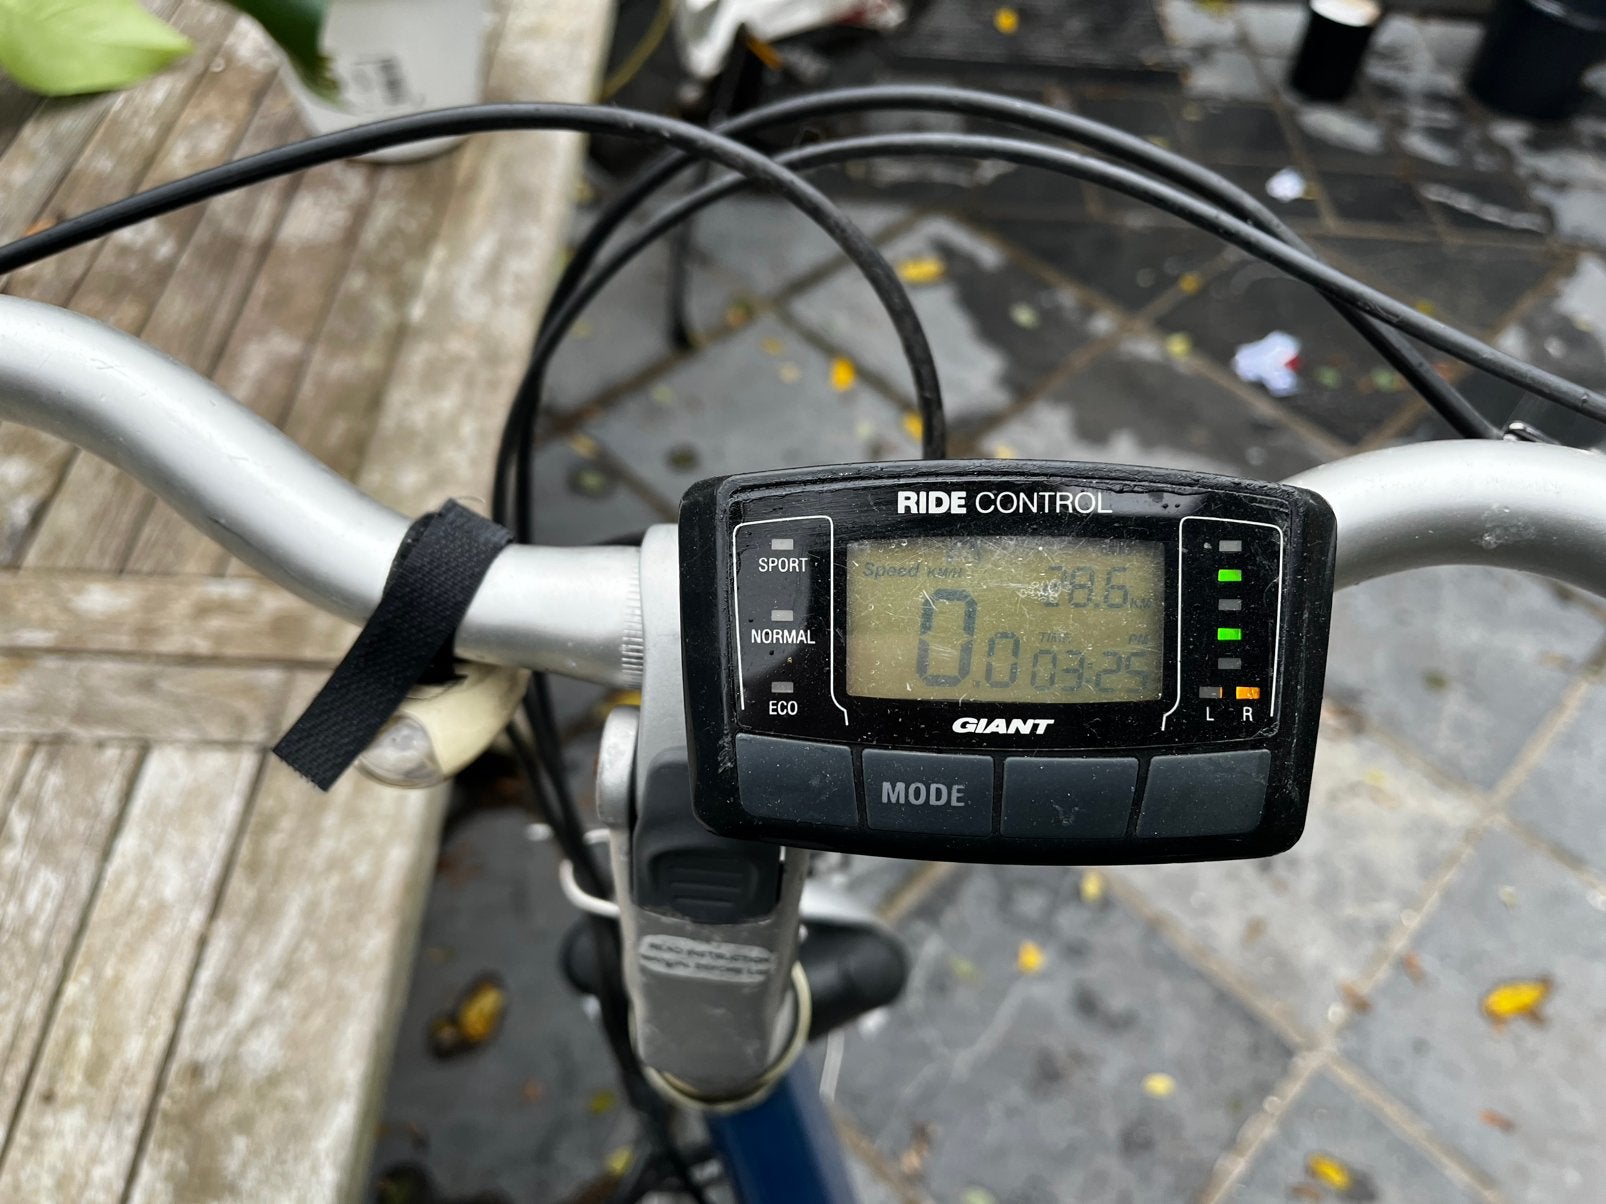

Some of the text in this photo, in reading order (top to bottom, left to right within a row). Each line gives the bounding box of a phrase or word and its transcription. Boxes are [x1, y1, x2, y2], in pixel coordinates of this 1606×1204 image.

[897, 491, 1113, 514] RIDE CONTROL
[758, 557, 809, 572] SPORT
[863, 562, 920, 579] Speed
[751, 629, 816, 644] NORMAL
[768, 700, 799, 716] ECO
[1206, 706, 1215, 722] L
[1242, 706, 1254, 722] R
[952, 717, 1055, 735] GIANT
[881, 781, 966, 807] MODE
